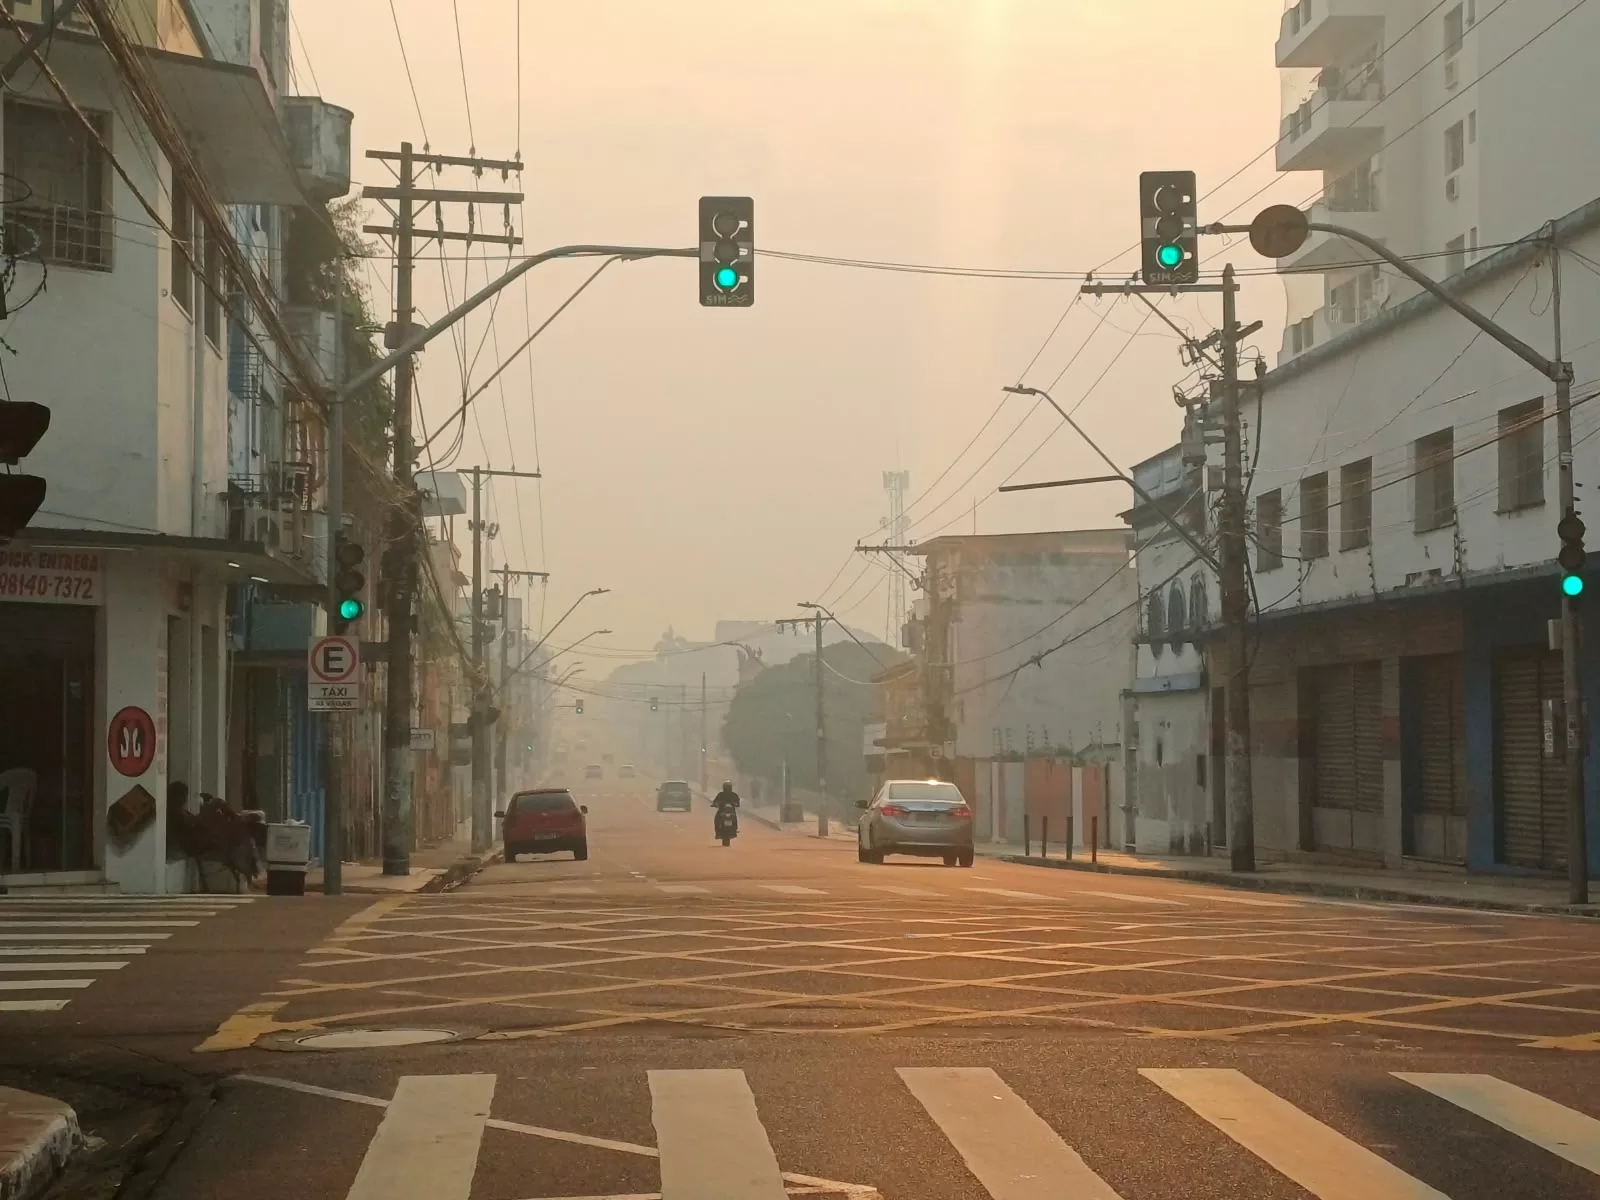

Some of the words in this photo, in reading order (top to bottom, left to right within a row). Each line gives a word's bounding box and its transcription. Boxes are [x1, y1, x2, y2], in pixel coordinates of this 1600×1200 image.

[706, 295, 727, 304] SIM
[39, 552, 98, 571] ENTREGA
[324, 647, 344, 672] E
[321, 688, 347, 696] TAXI
